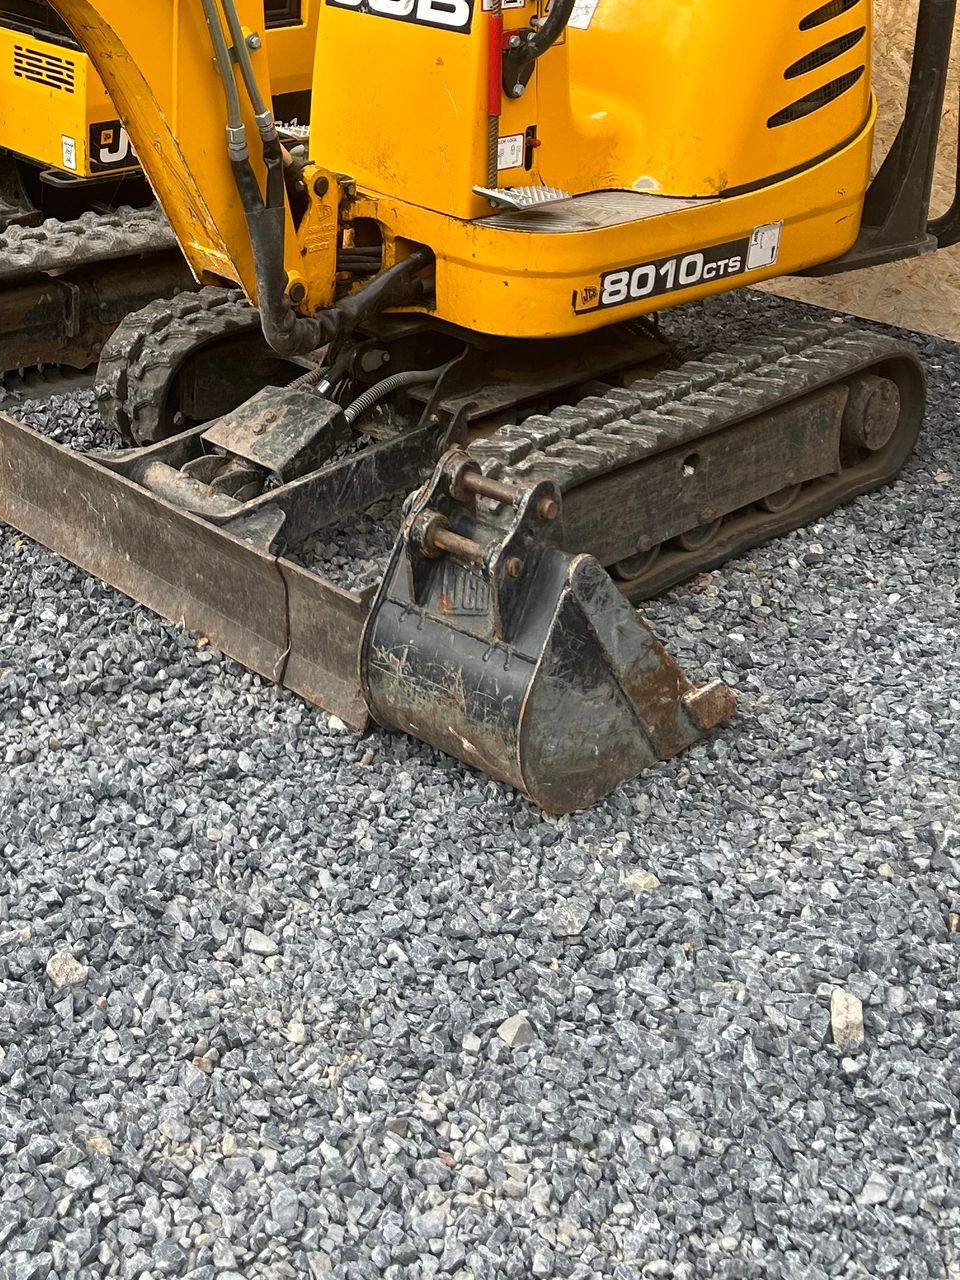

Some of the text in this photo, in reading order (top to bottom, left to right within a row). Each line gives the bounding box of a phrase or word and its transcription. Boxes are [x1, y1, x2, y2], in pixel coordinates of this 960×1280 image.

[581, 287, 597, 305] JCB
[601, 252, 741, 305] 8010 CTS
